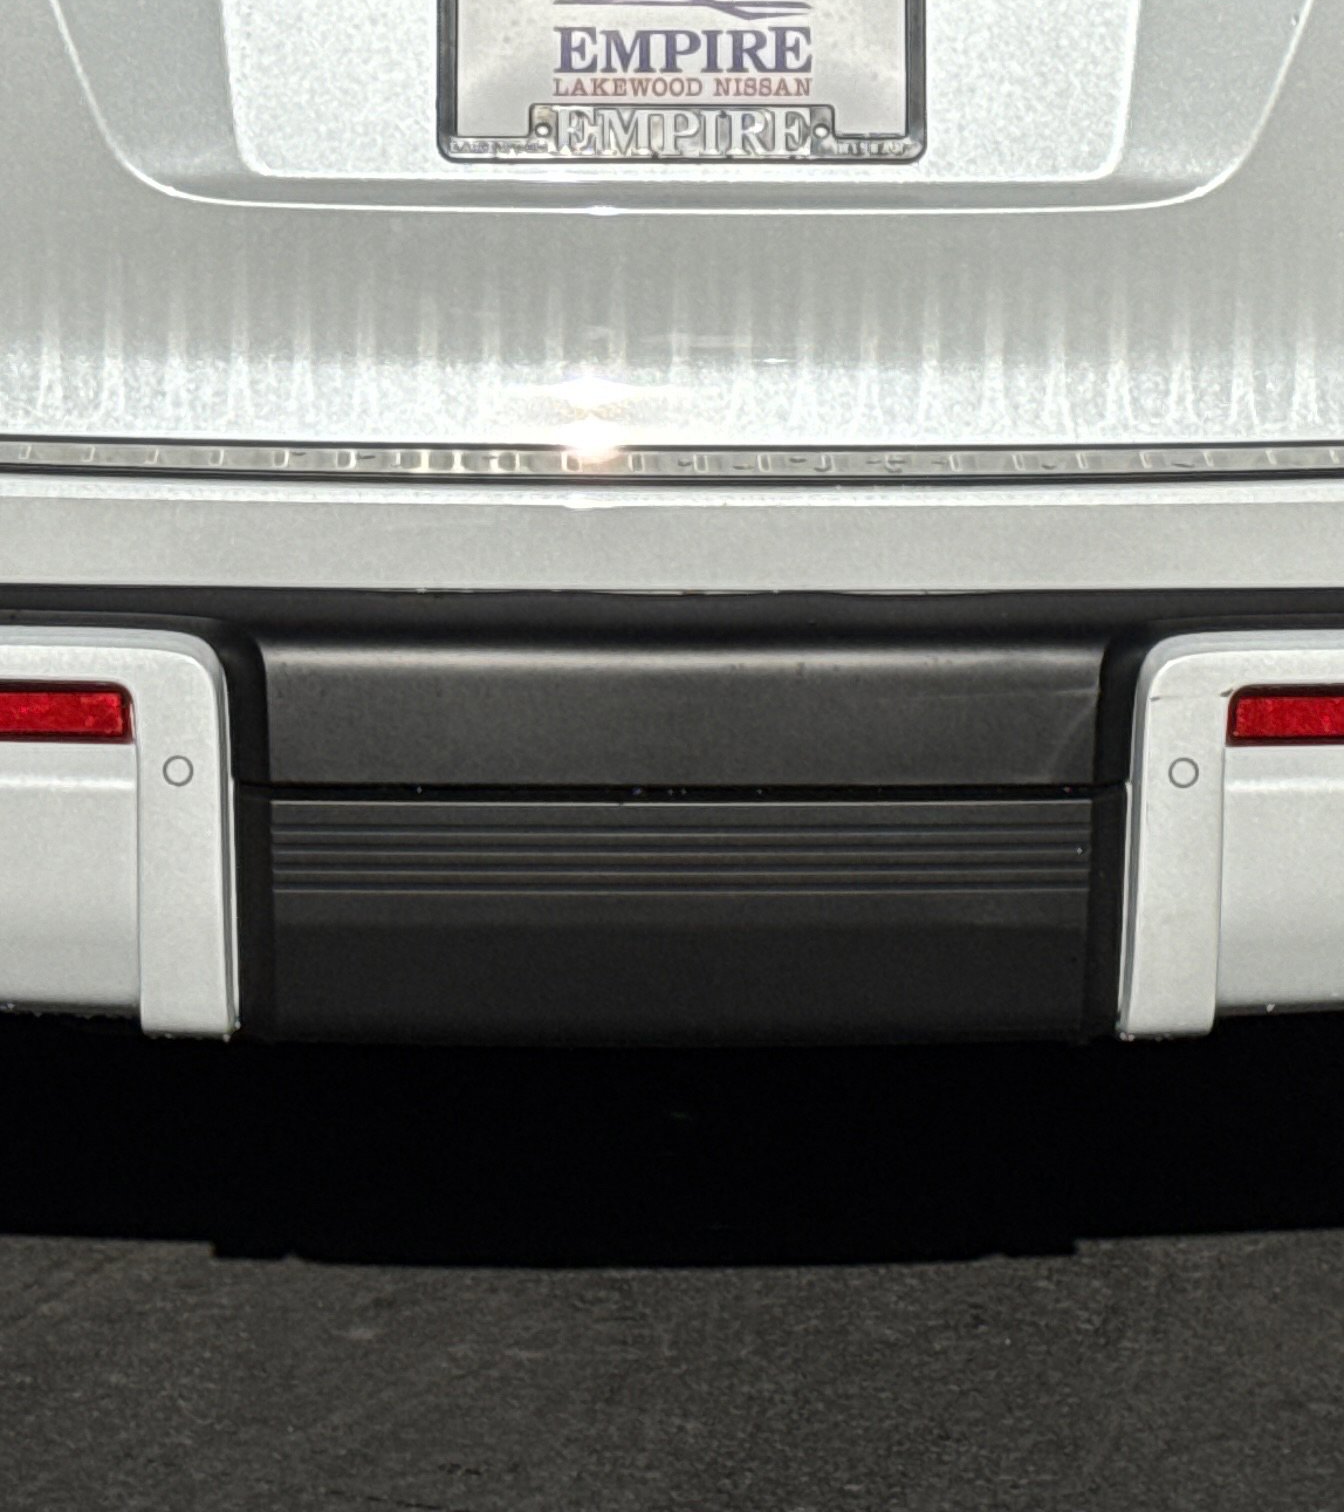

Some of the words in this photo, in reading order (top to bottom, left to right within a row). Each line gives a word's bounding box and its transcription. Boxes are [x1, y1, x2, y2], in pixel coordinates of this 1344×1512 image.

[553, 26, 813, 74] EMPIRE
[552, 77, 704, 97] LAKEWOOD
[712, 77, 813, 97] NISSAN
[553, 106, 811, 157] EMPIRE
